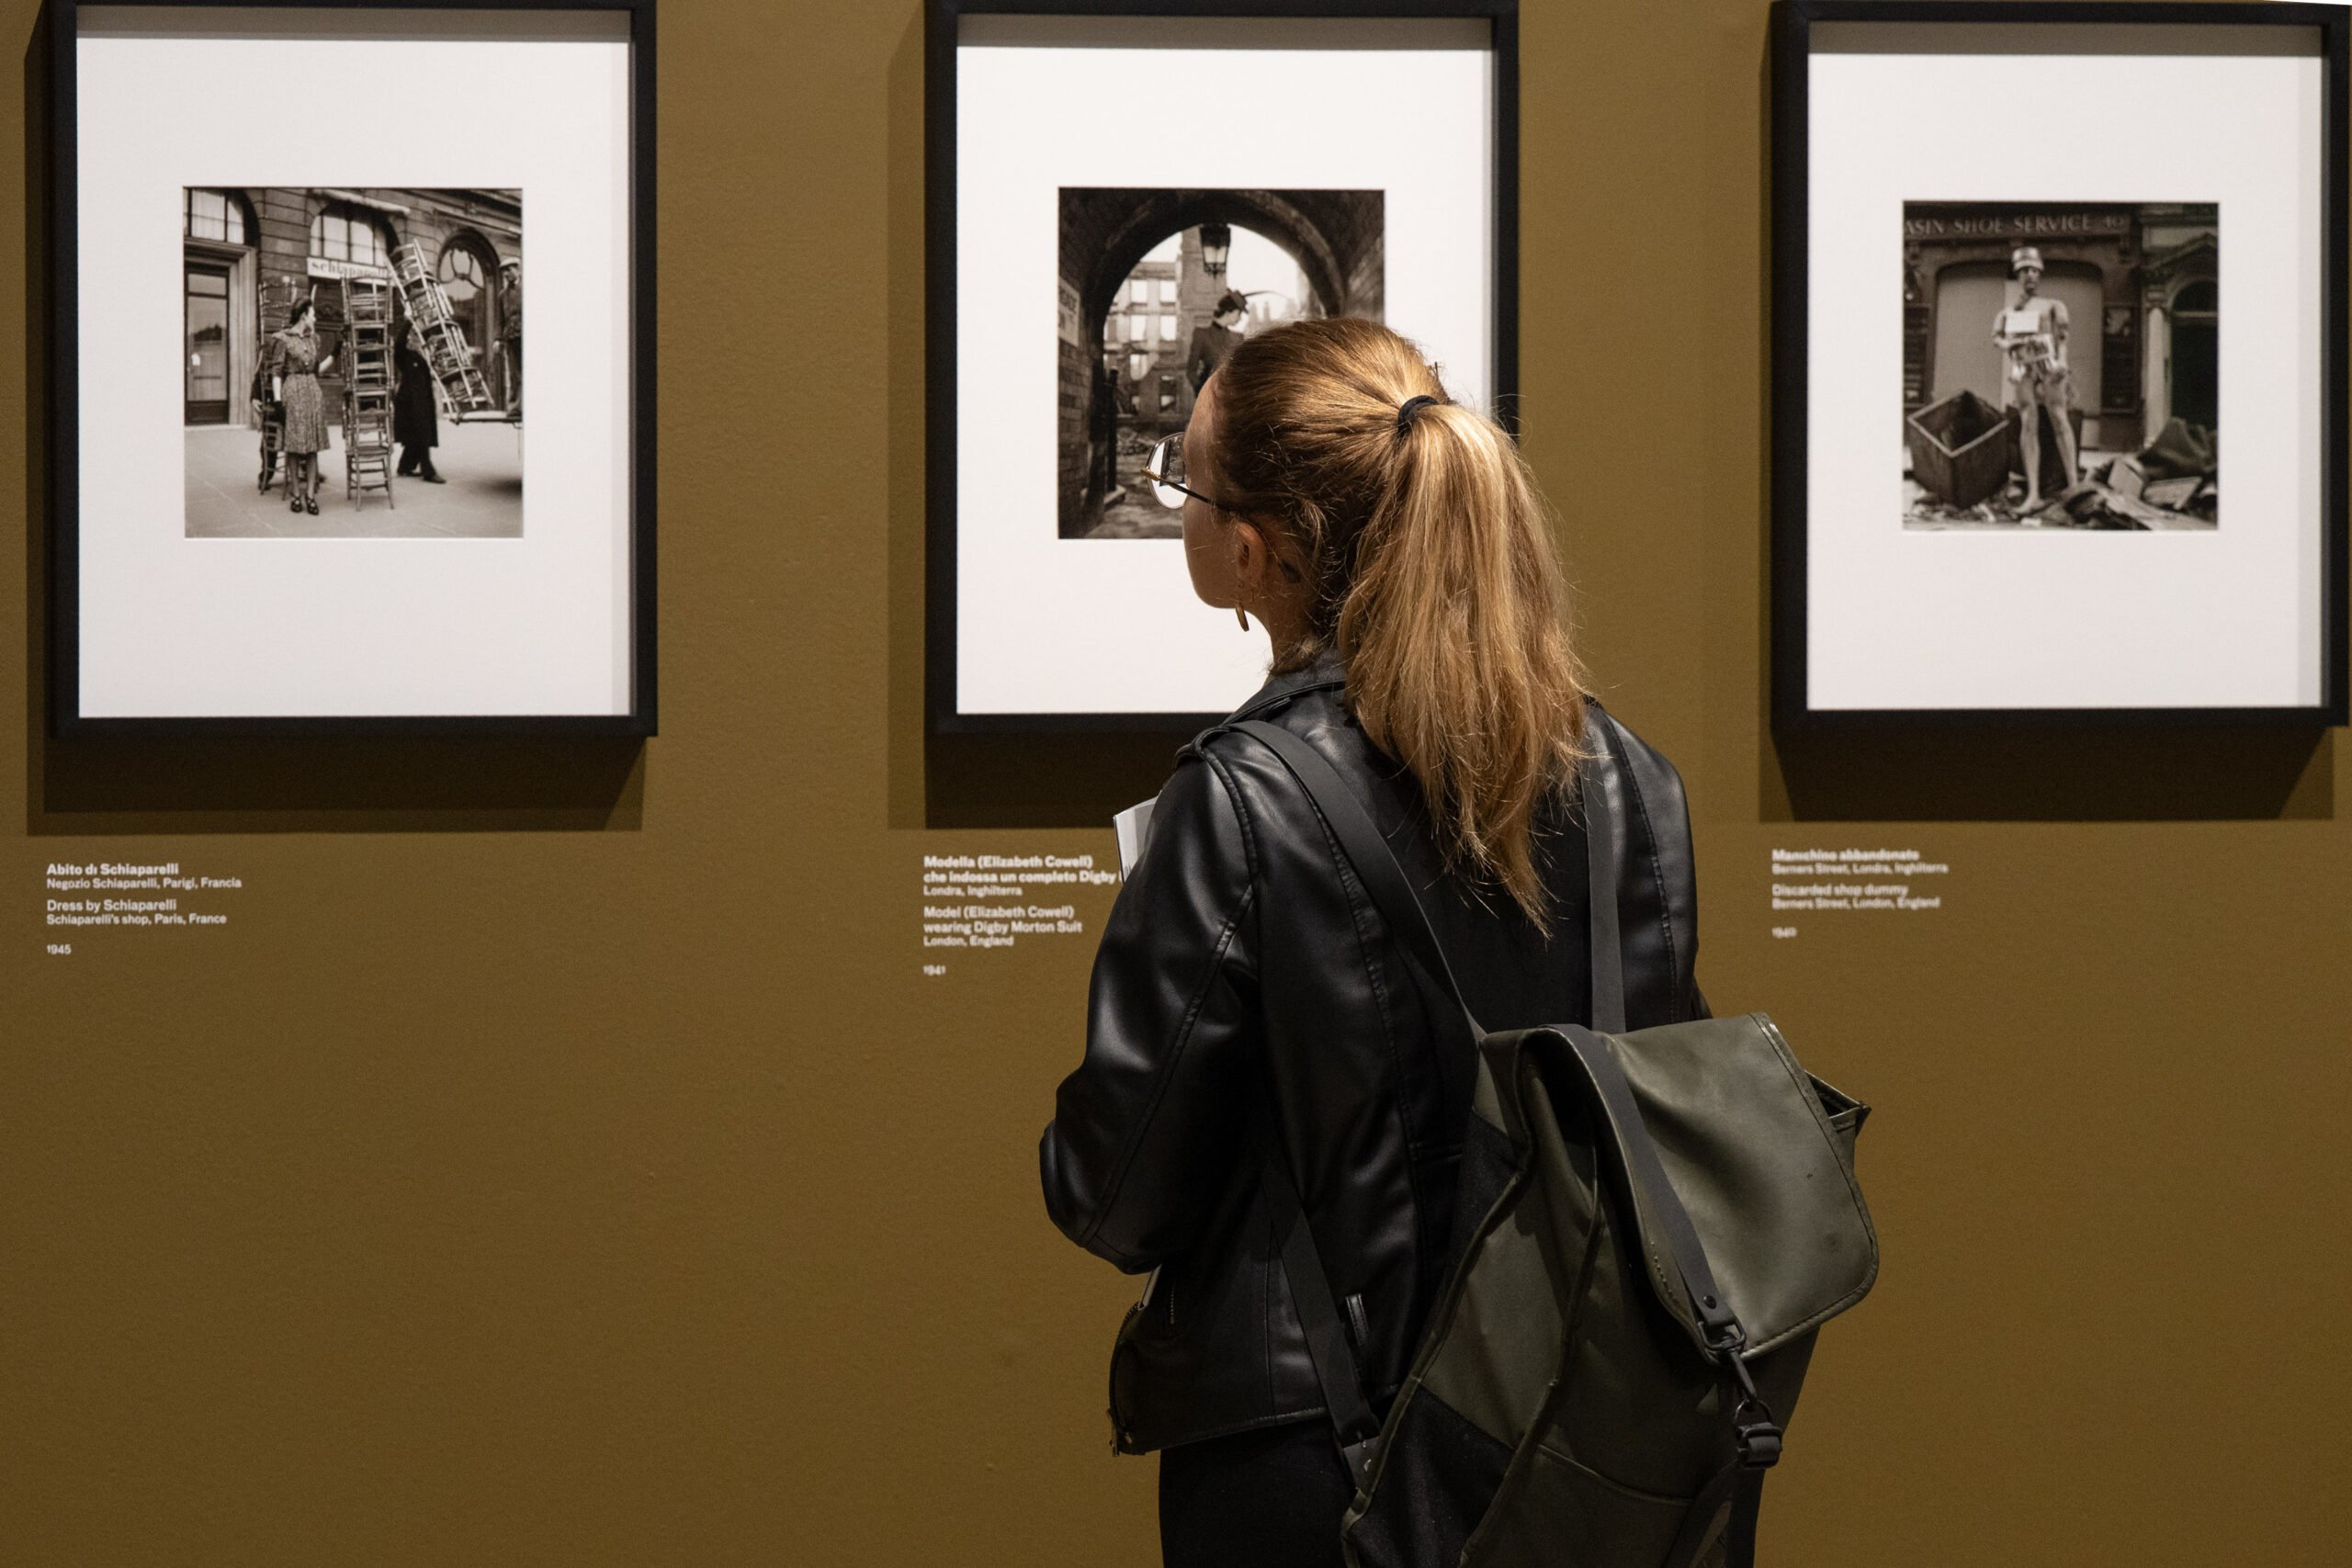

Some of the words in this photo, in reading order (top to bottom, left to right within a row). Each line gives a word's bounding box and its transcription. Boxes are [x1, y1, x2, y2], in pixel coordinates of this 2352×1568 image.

[1953, 217, 2003, 234] SHOE
[2013, 214, 2088, 232] SERVICE
[923, 855, 976, 869] Modella
[977, 855, 1043, 870] (Elizabeth
[1045, 855, 1093, 870] Cowell)
[47, 863, 83, 875] Abito
[85, 863, 97, 875] di
[100, 863, 178, 877] Schiaparelli
[47, 877, 90, 890] Negozio
[93, 877, 160, 890] Schiaparelli,
[163, 877, 198, 890] Parigi,
[201, 876, 242, 888] Francia
[923, 871, 947, 883] che
[949, 871, 998, 883] indossa
[1000, 873, 1017, 883] un
[1018, 871, 1078, 886] completo
[1079, 870, 1116, 885] Digby
[923, 886, 966, 897] Londra,
[967, 885, 1023, 898] Inghilterra
[1772, 884, 1832, 897] Discarded
[1834, 884, 1863, 897] shop
[1864, 884, 1908, 898] dummy
[47, 899, 83, 911] Dress
[85, 898, 101, 913] by
[103, 898, 176, 913] Schiaparelli
[1852, 897, 1895, 909] London,
[1896, 896, 1940, 910] England
[47, 913, 119, 926] Schiaparelli's
[122, 913, 152, 926] shop,
[154, 913, 186, 925] Paris,
[188, 912, 227, 924] France
[923, 906, 961, 919] Model
[963, 906, 1026, 919] (Elizabeth
[1027, 906, 1074, 919] Cowell)
[923, 920, 972, 935] wearing
[974, 920, 1009, 935] Digby
[1011, 920, 1055, 932] Morton
[1057, 919, 1082, 932] Suit
[923, 935, 967, 947] London,
[969, 935, 1014, 949] England
[47, 944, 71, 955] 1945
[923, 964, 945, 976] 1941
